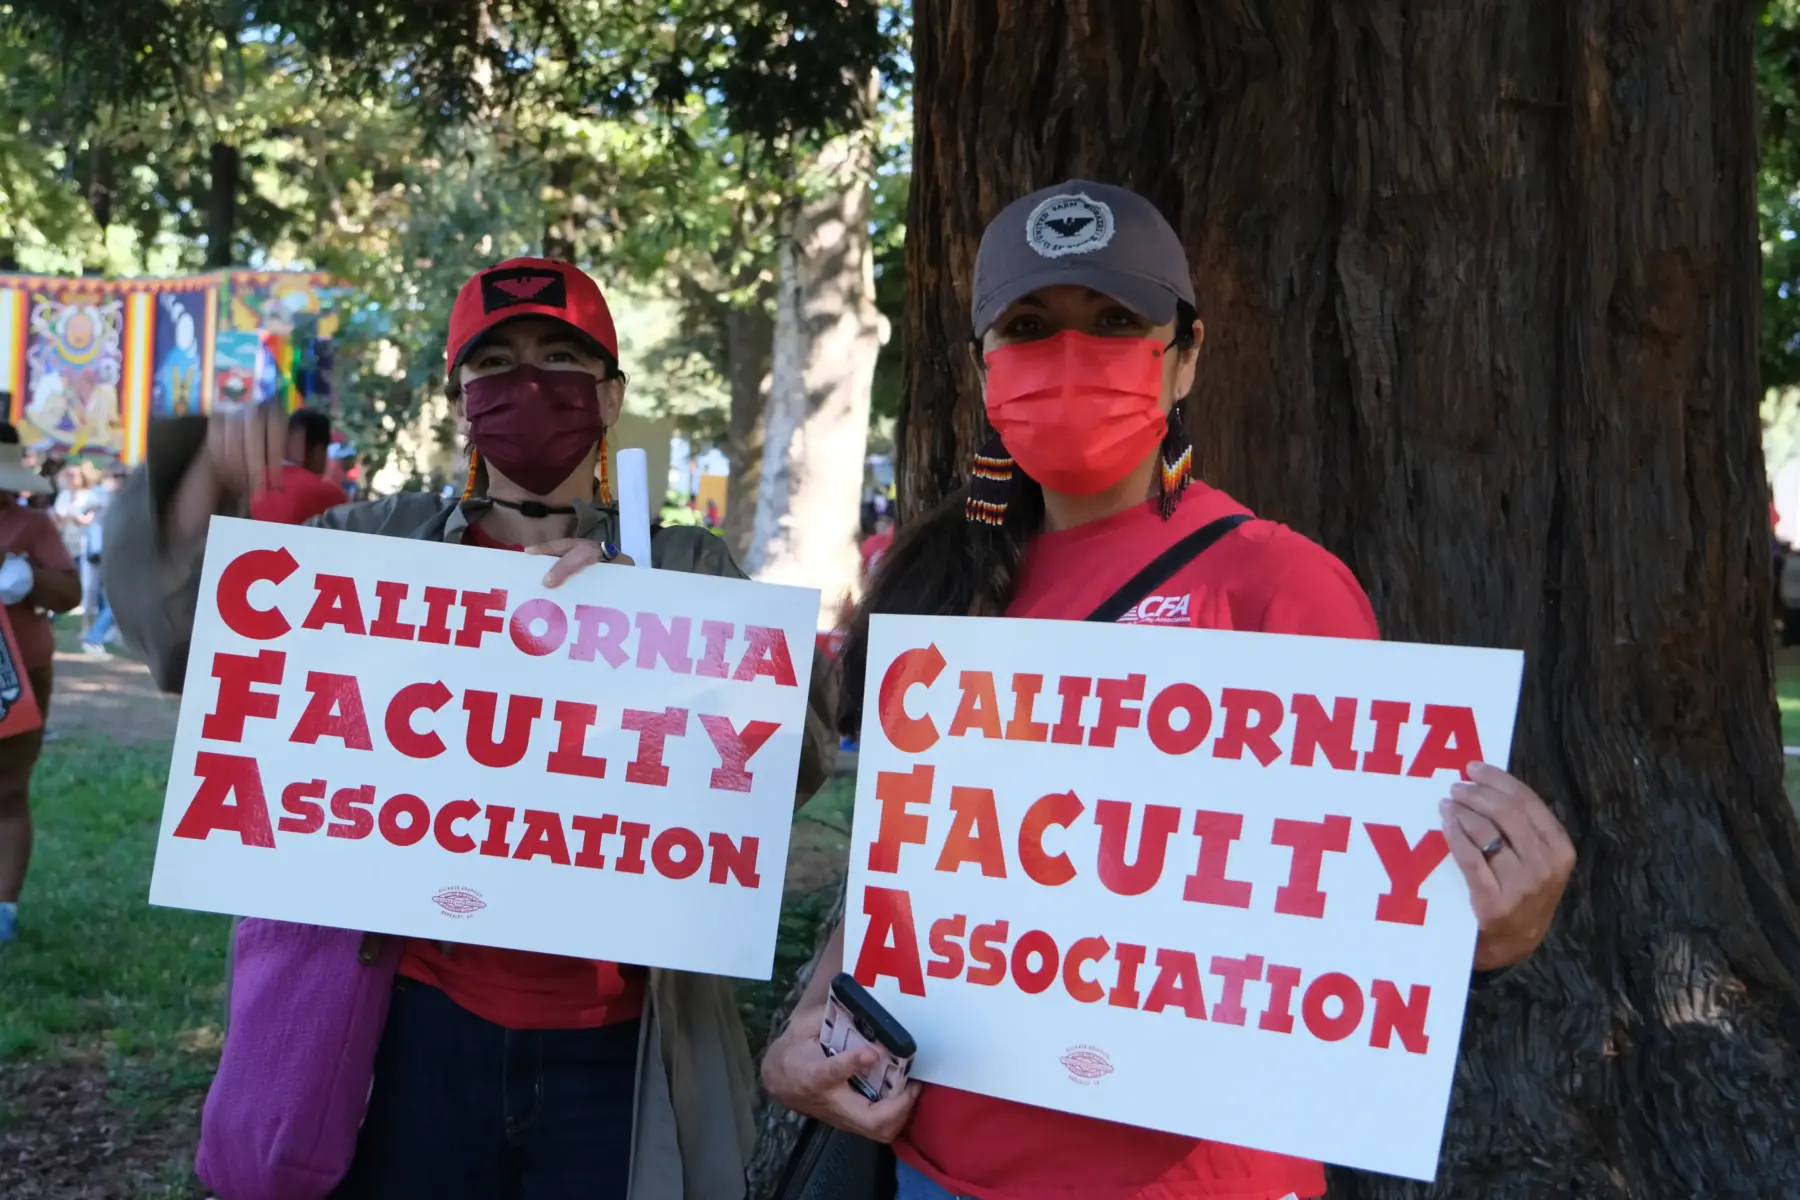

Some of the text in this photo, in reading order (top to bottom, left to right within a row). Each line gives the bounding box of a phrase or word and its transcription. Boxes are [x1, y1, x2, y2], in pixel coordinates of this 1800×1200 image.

[216, 546, 798, 688] CALIFORNIA
[1138, 594, 1191, 619] CFA
[201, 649, 782, 792] FACULTY
[878, 643, 1484, 782] CALIFORNIA
[174, 751, 761, 889] ASSOCIATION
[867, 764, 1451, 926] FACULTY
[853, 885, 1431, 1055] ASSOCIATION
